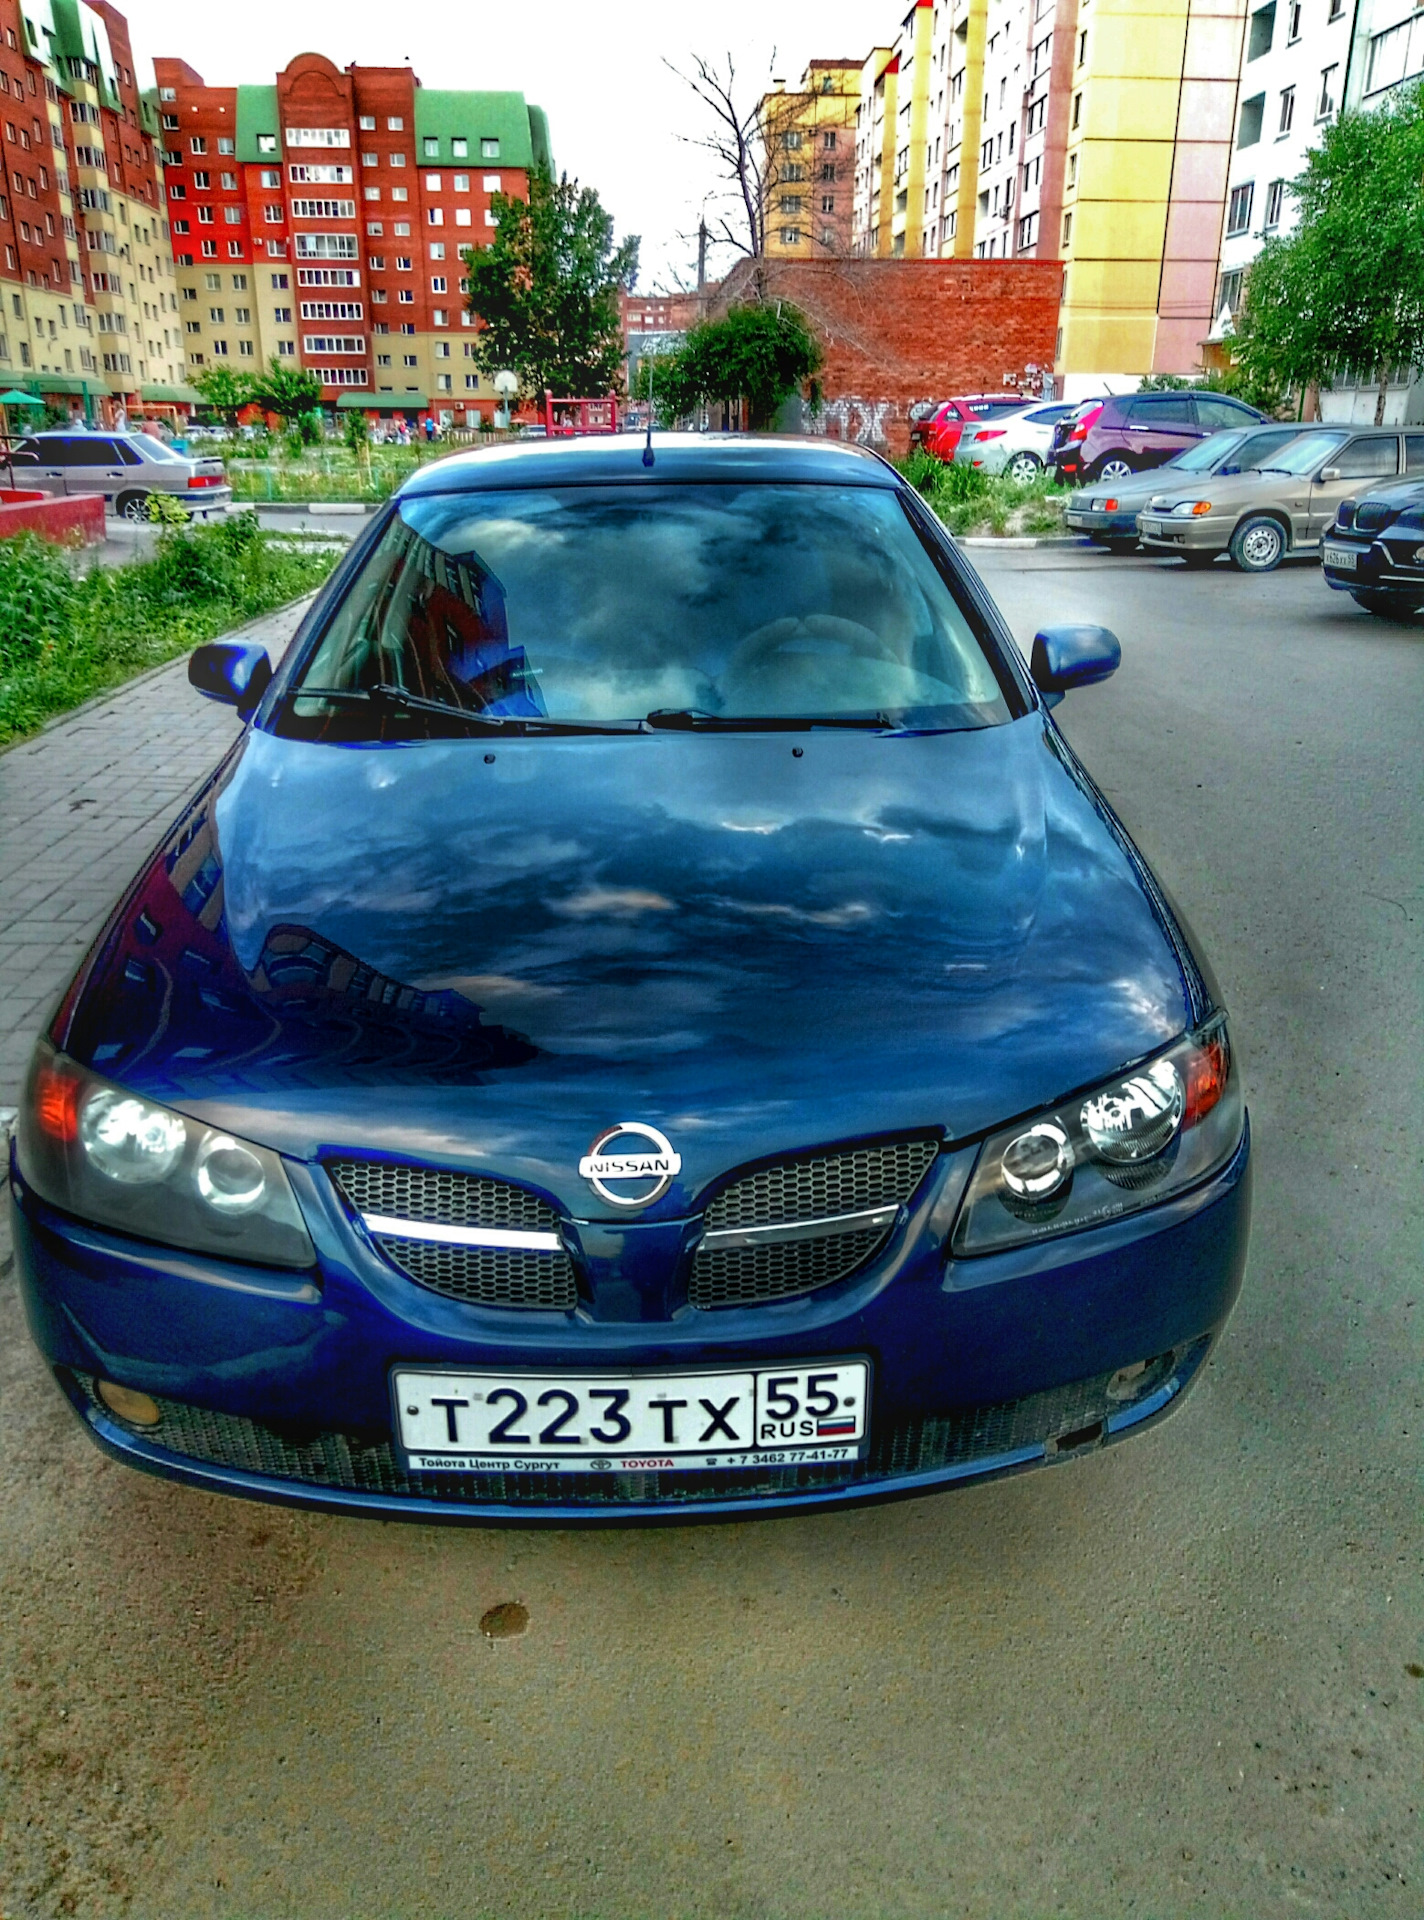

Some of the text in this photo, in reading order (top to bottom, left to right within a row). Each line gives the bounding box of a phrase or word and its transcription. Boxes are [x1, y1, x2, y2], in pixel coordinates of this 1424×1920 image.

[590, 1160, 669, 1173] NISSAN
[765, 1373, 839, 1420] 55
[760, 1420, 814, 1440] RUS
[620, 1458, 675, 1469] TOYOTA
[752, 1453, 785, 1464] 3462
[789, 1448, 849, 1461] 77-41-77
[419, 1457, 560, 1471] Тойота Центр Сургут
